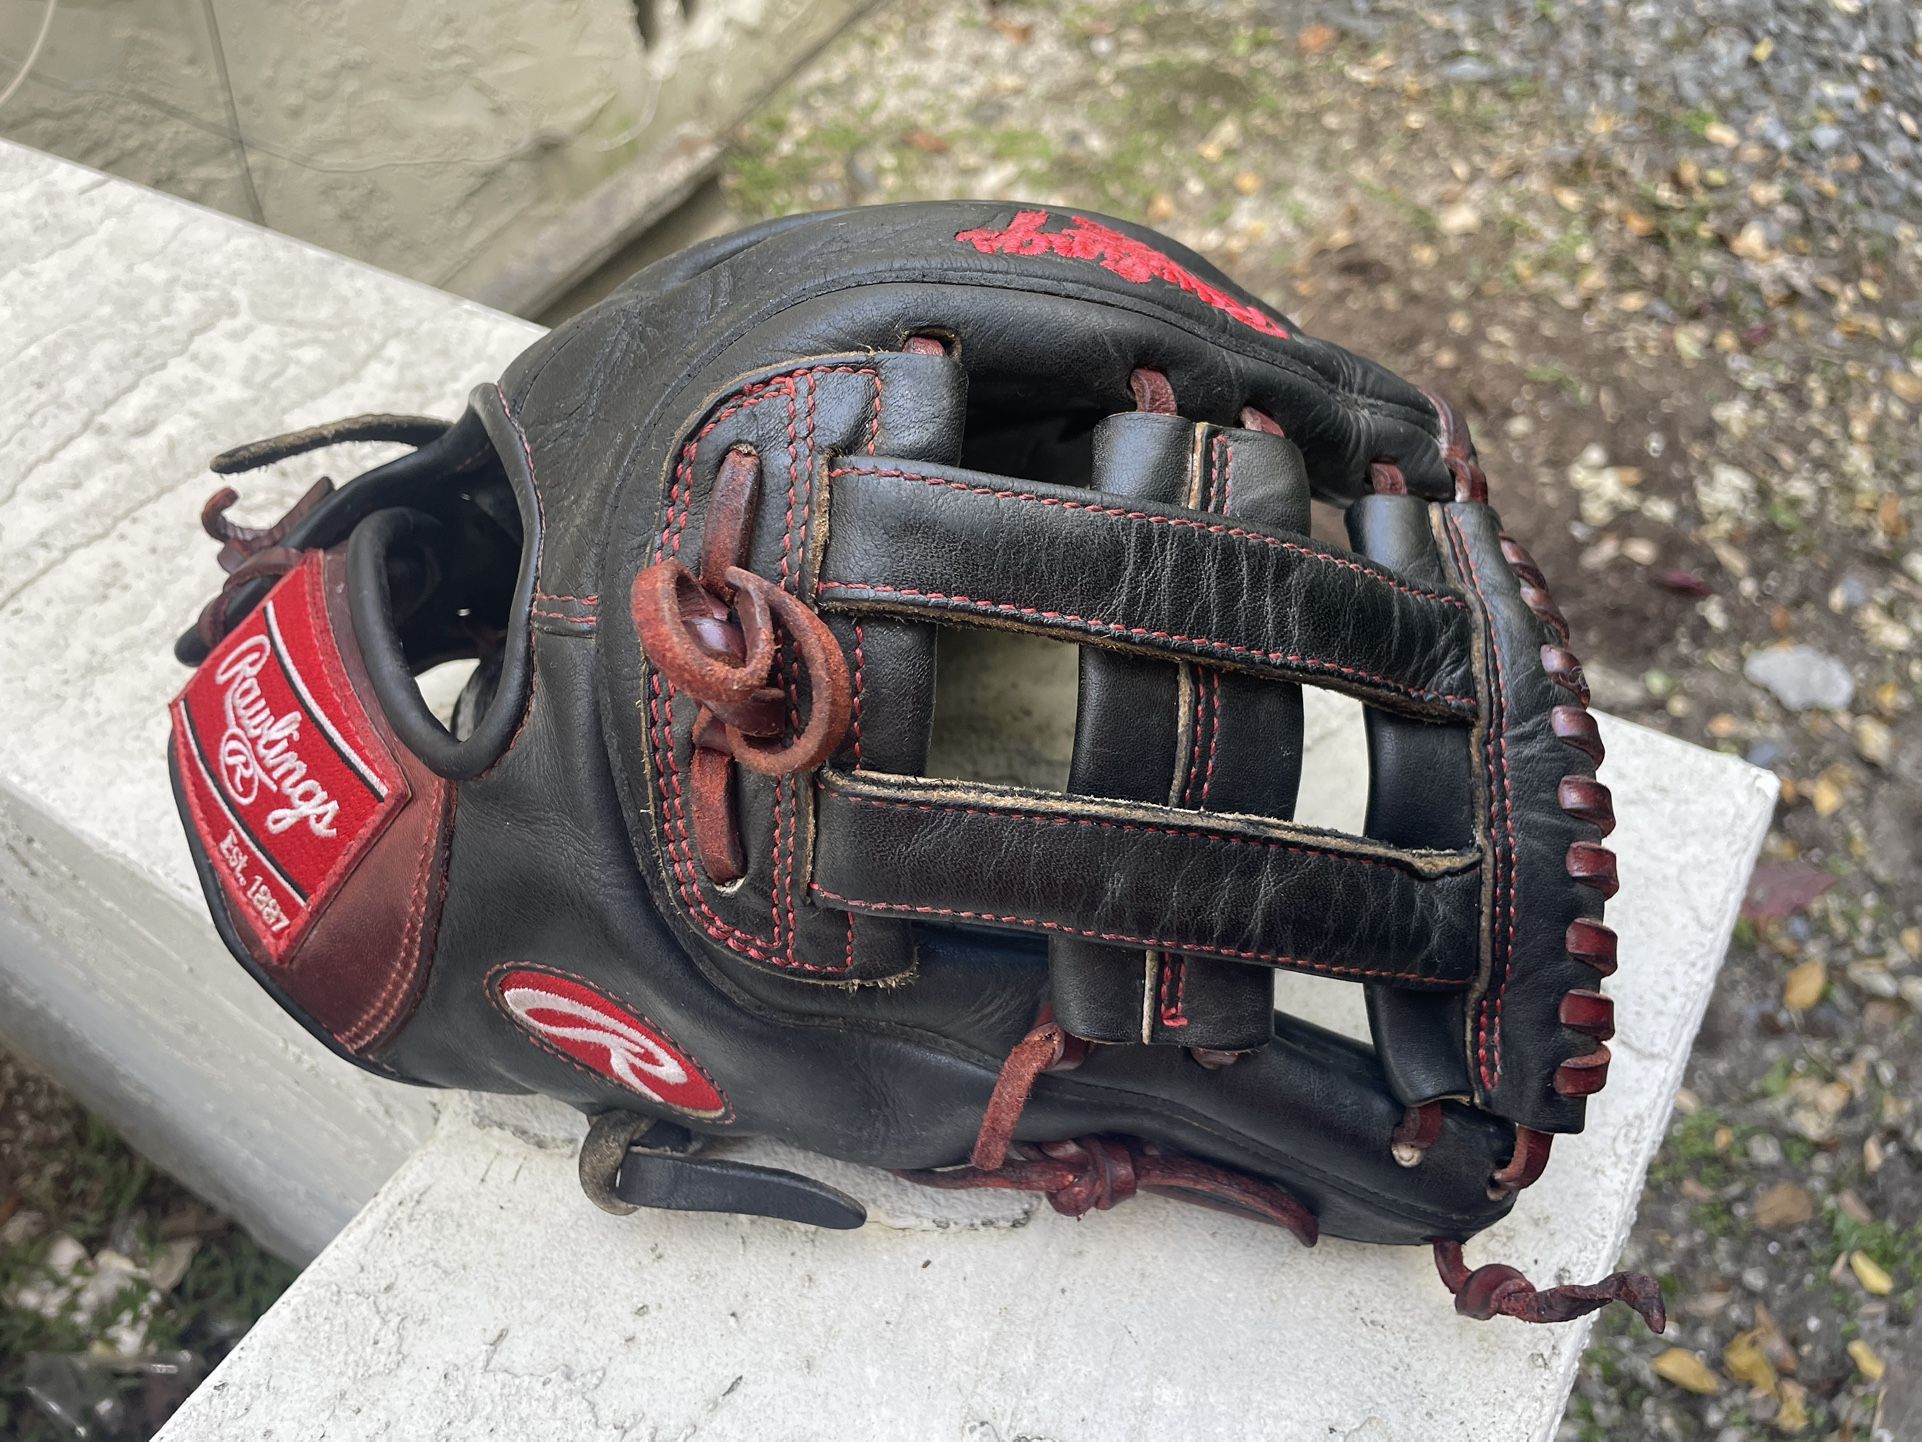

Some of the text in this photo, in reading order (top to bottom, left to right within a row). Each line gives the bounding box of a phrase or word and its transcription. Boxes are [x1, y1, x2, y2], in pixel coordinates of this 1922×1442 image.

[215, 634, 340, 837] Rawlings
[220, 828, 291, 933] Est. 1887
